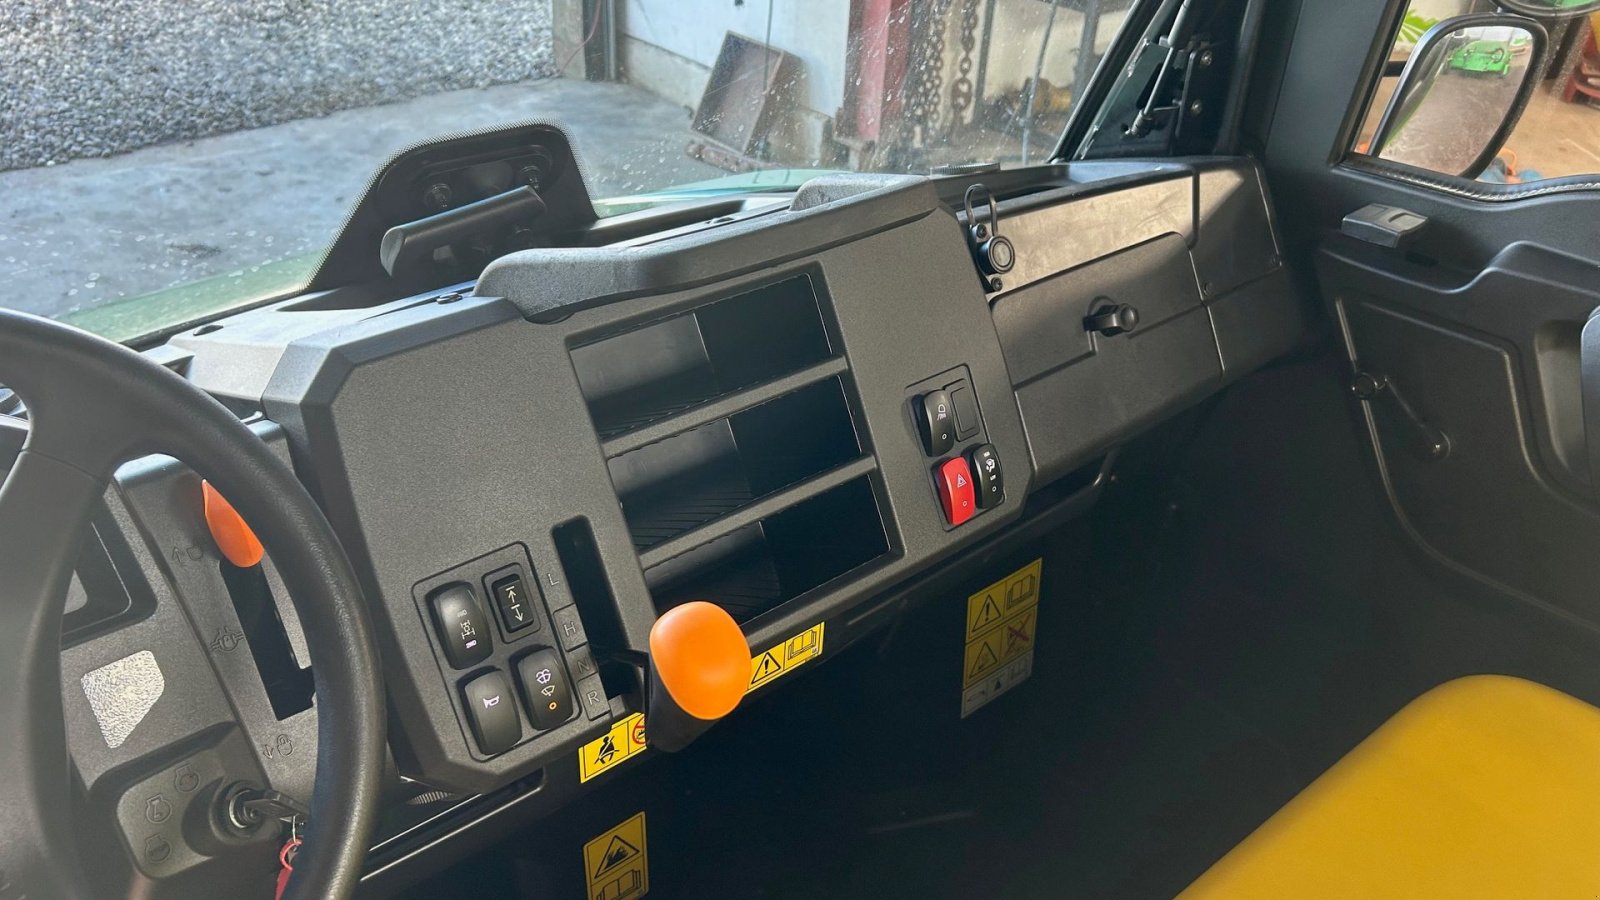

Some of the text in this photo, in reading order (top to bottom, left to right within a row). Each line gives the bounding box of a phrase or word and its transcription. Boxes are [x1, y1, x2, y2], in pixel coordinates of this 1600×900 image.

[547, 573, 560, 586] L
[563, 621, 576, 636] H
[577, 658, 591, 674] N
[586, 690, 600, 706] R
